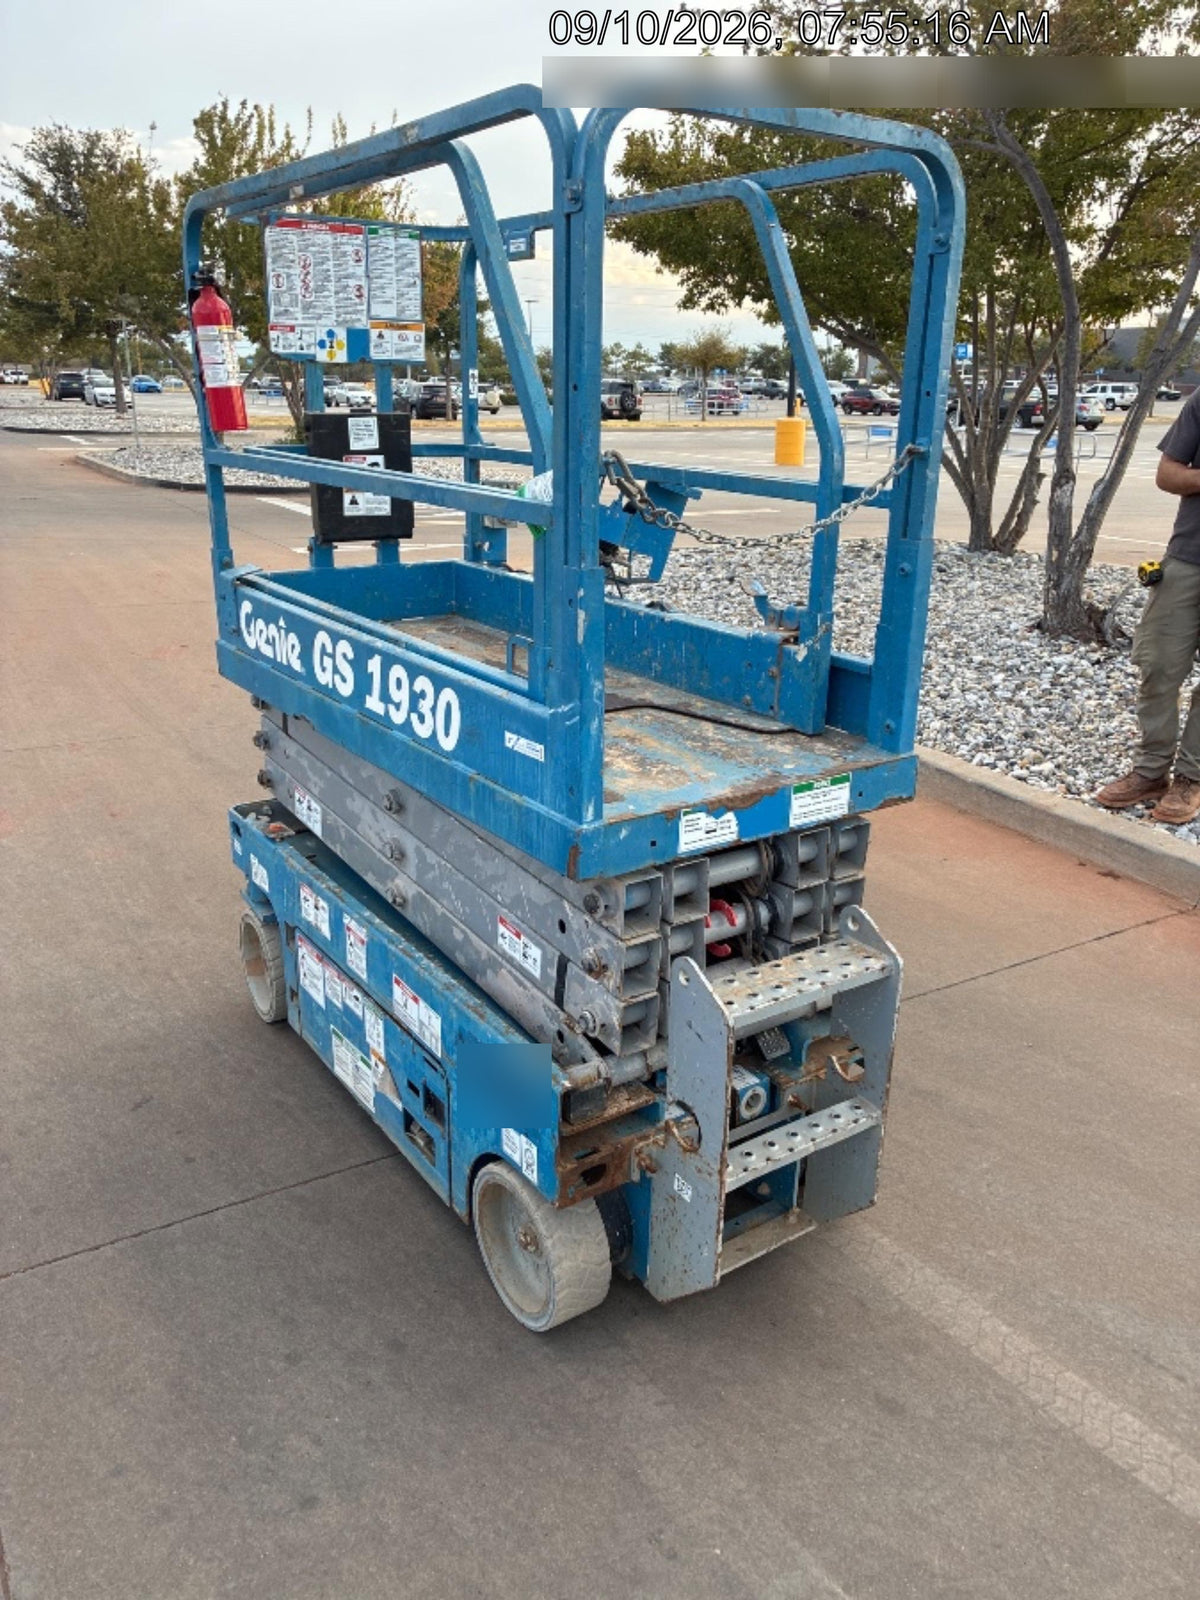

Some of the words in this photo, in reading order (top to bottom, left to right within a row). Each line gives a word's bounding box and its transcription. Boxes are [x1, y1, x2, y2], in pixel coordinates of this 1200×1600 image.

[240, 600, 306, 675] Genie
[313, 630, 354, 697] GS
[365, 654, 461, 751] 1930
